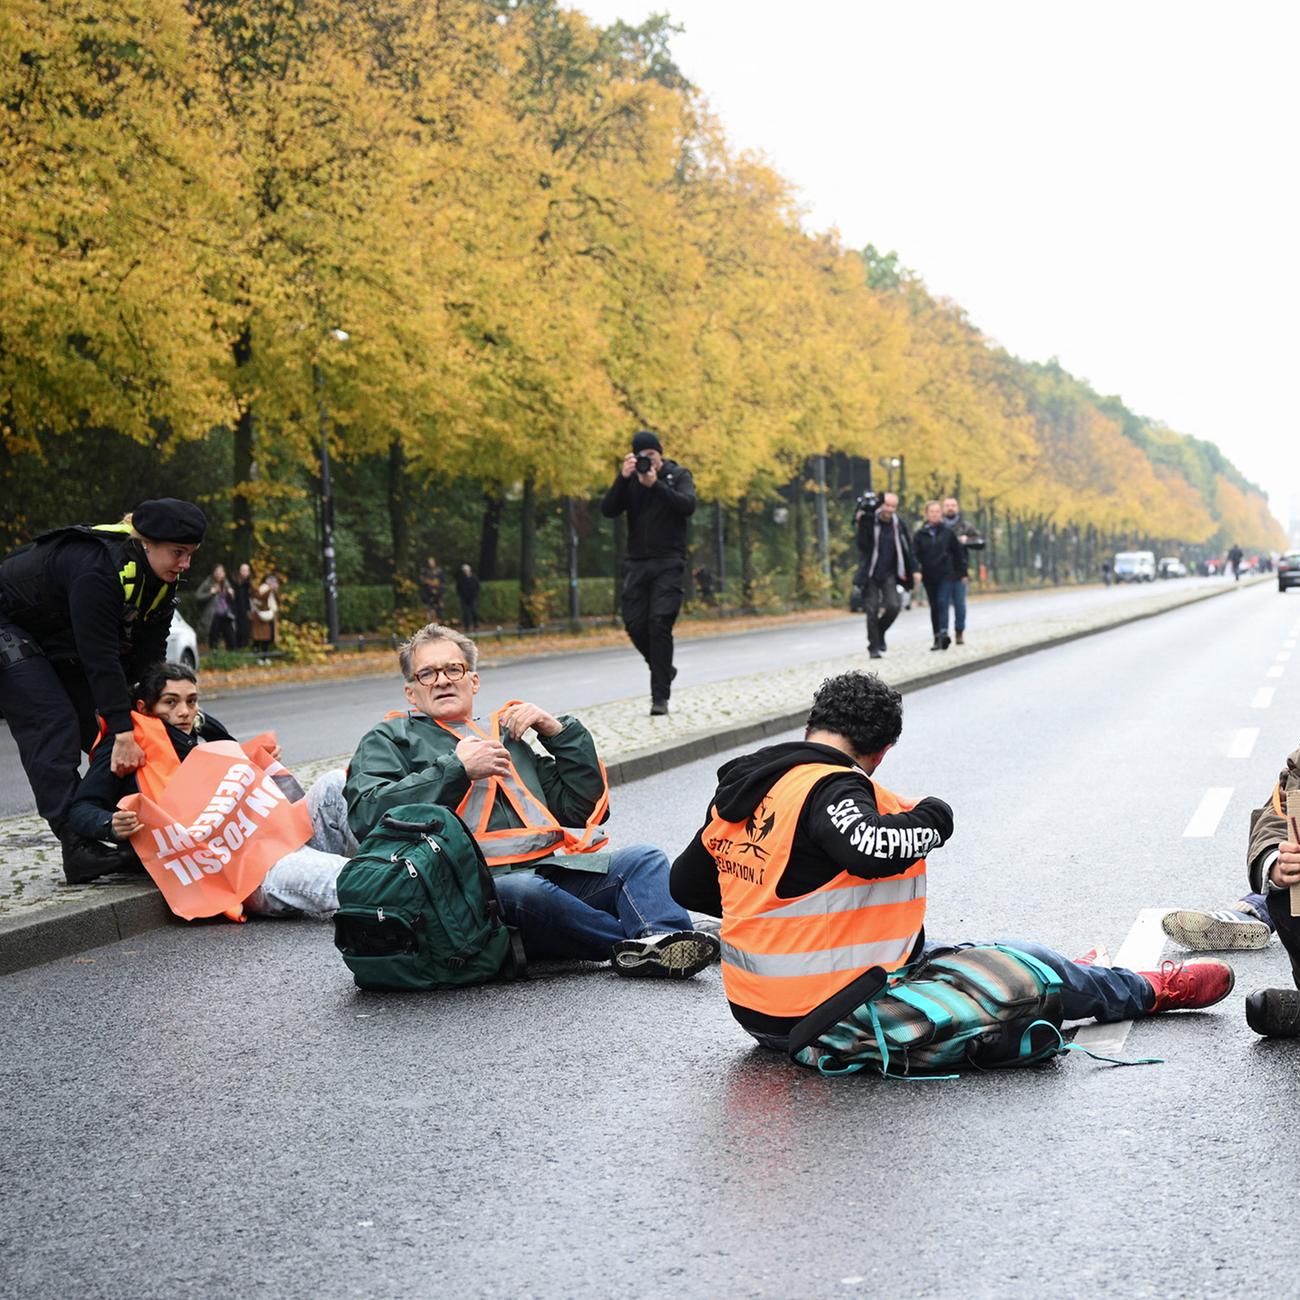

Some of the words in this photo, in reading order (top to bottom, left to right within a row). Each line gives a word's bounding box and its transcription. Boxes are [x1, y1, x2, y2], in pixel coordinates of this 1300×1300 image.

[163, 808, 258, 886] FOSSIL
[826, 798, 863, 834] SEA
[850, 822, 942, 860] SHEPHERD
